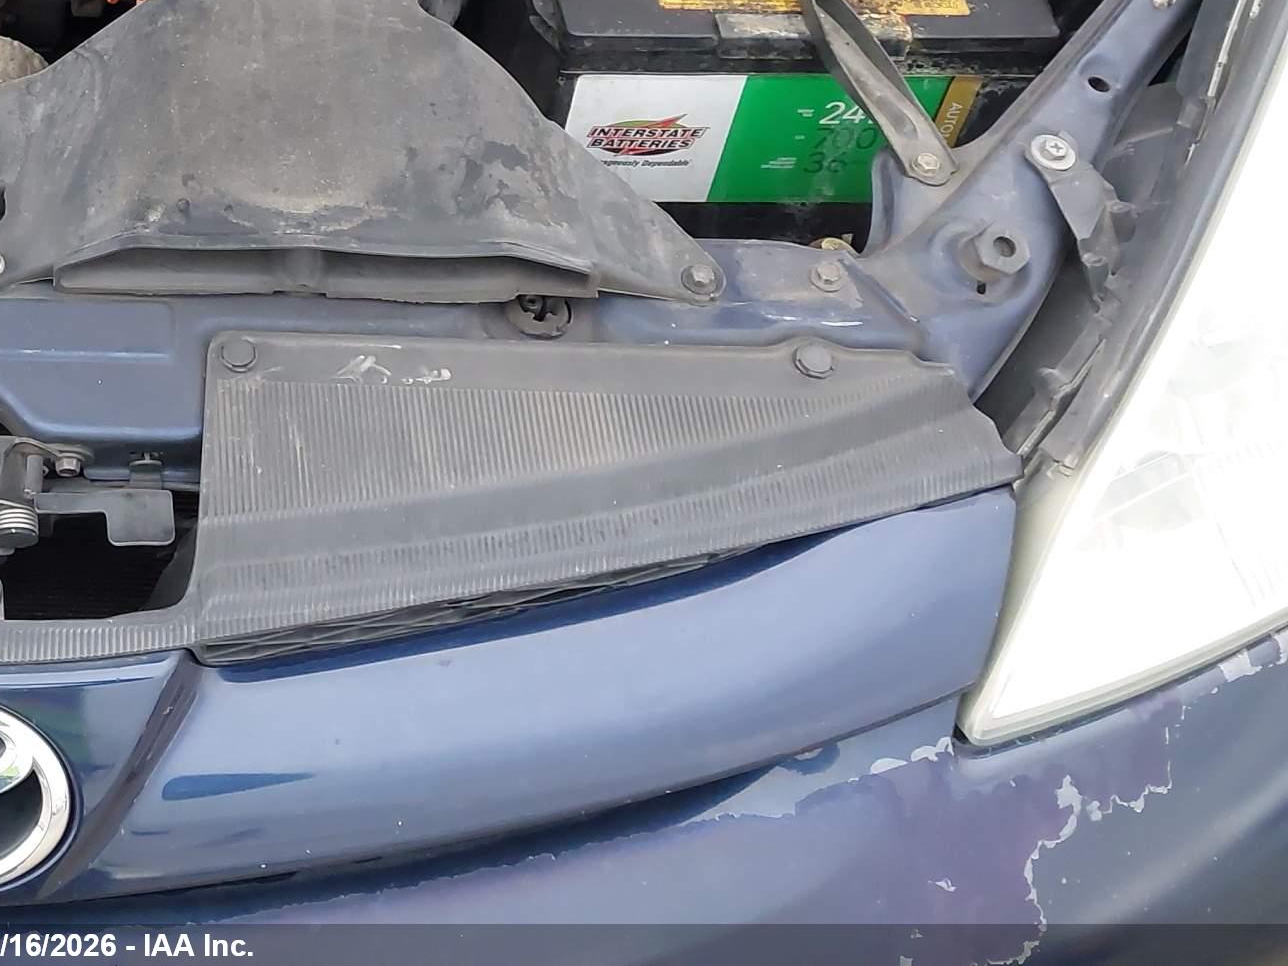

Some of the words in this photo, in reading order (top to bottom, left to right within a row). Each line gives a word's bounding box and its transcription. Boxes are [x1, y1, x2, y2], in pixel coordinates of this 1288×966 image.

[818, 101, 874, 125] 24
[590, 127, 705, 138] INTERSTATE
[813, 127, 877, 150] 700
[590, 138, 693, 149] BATTERIES
